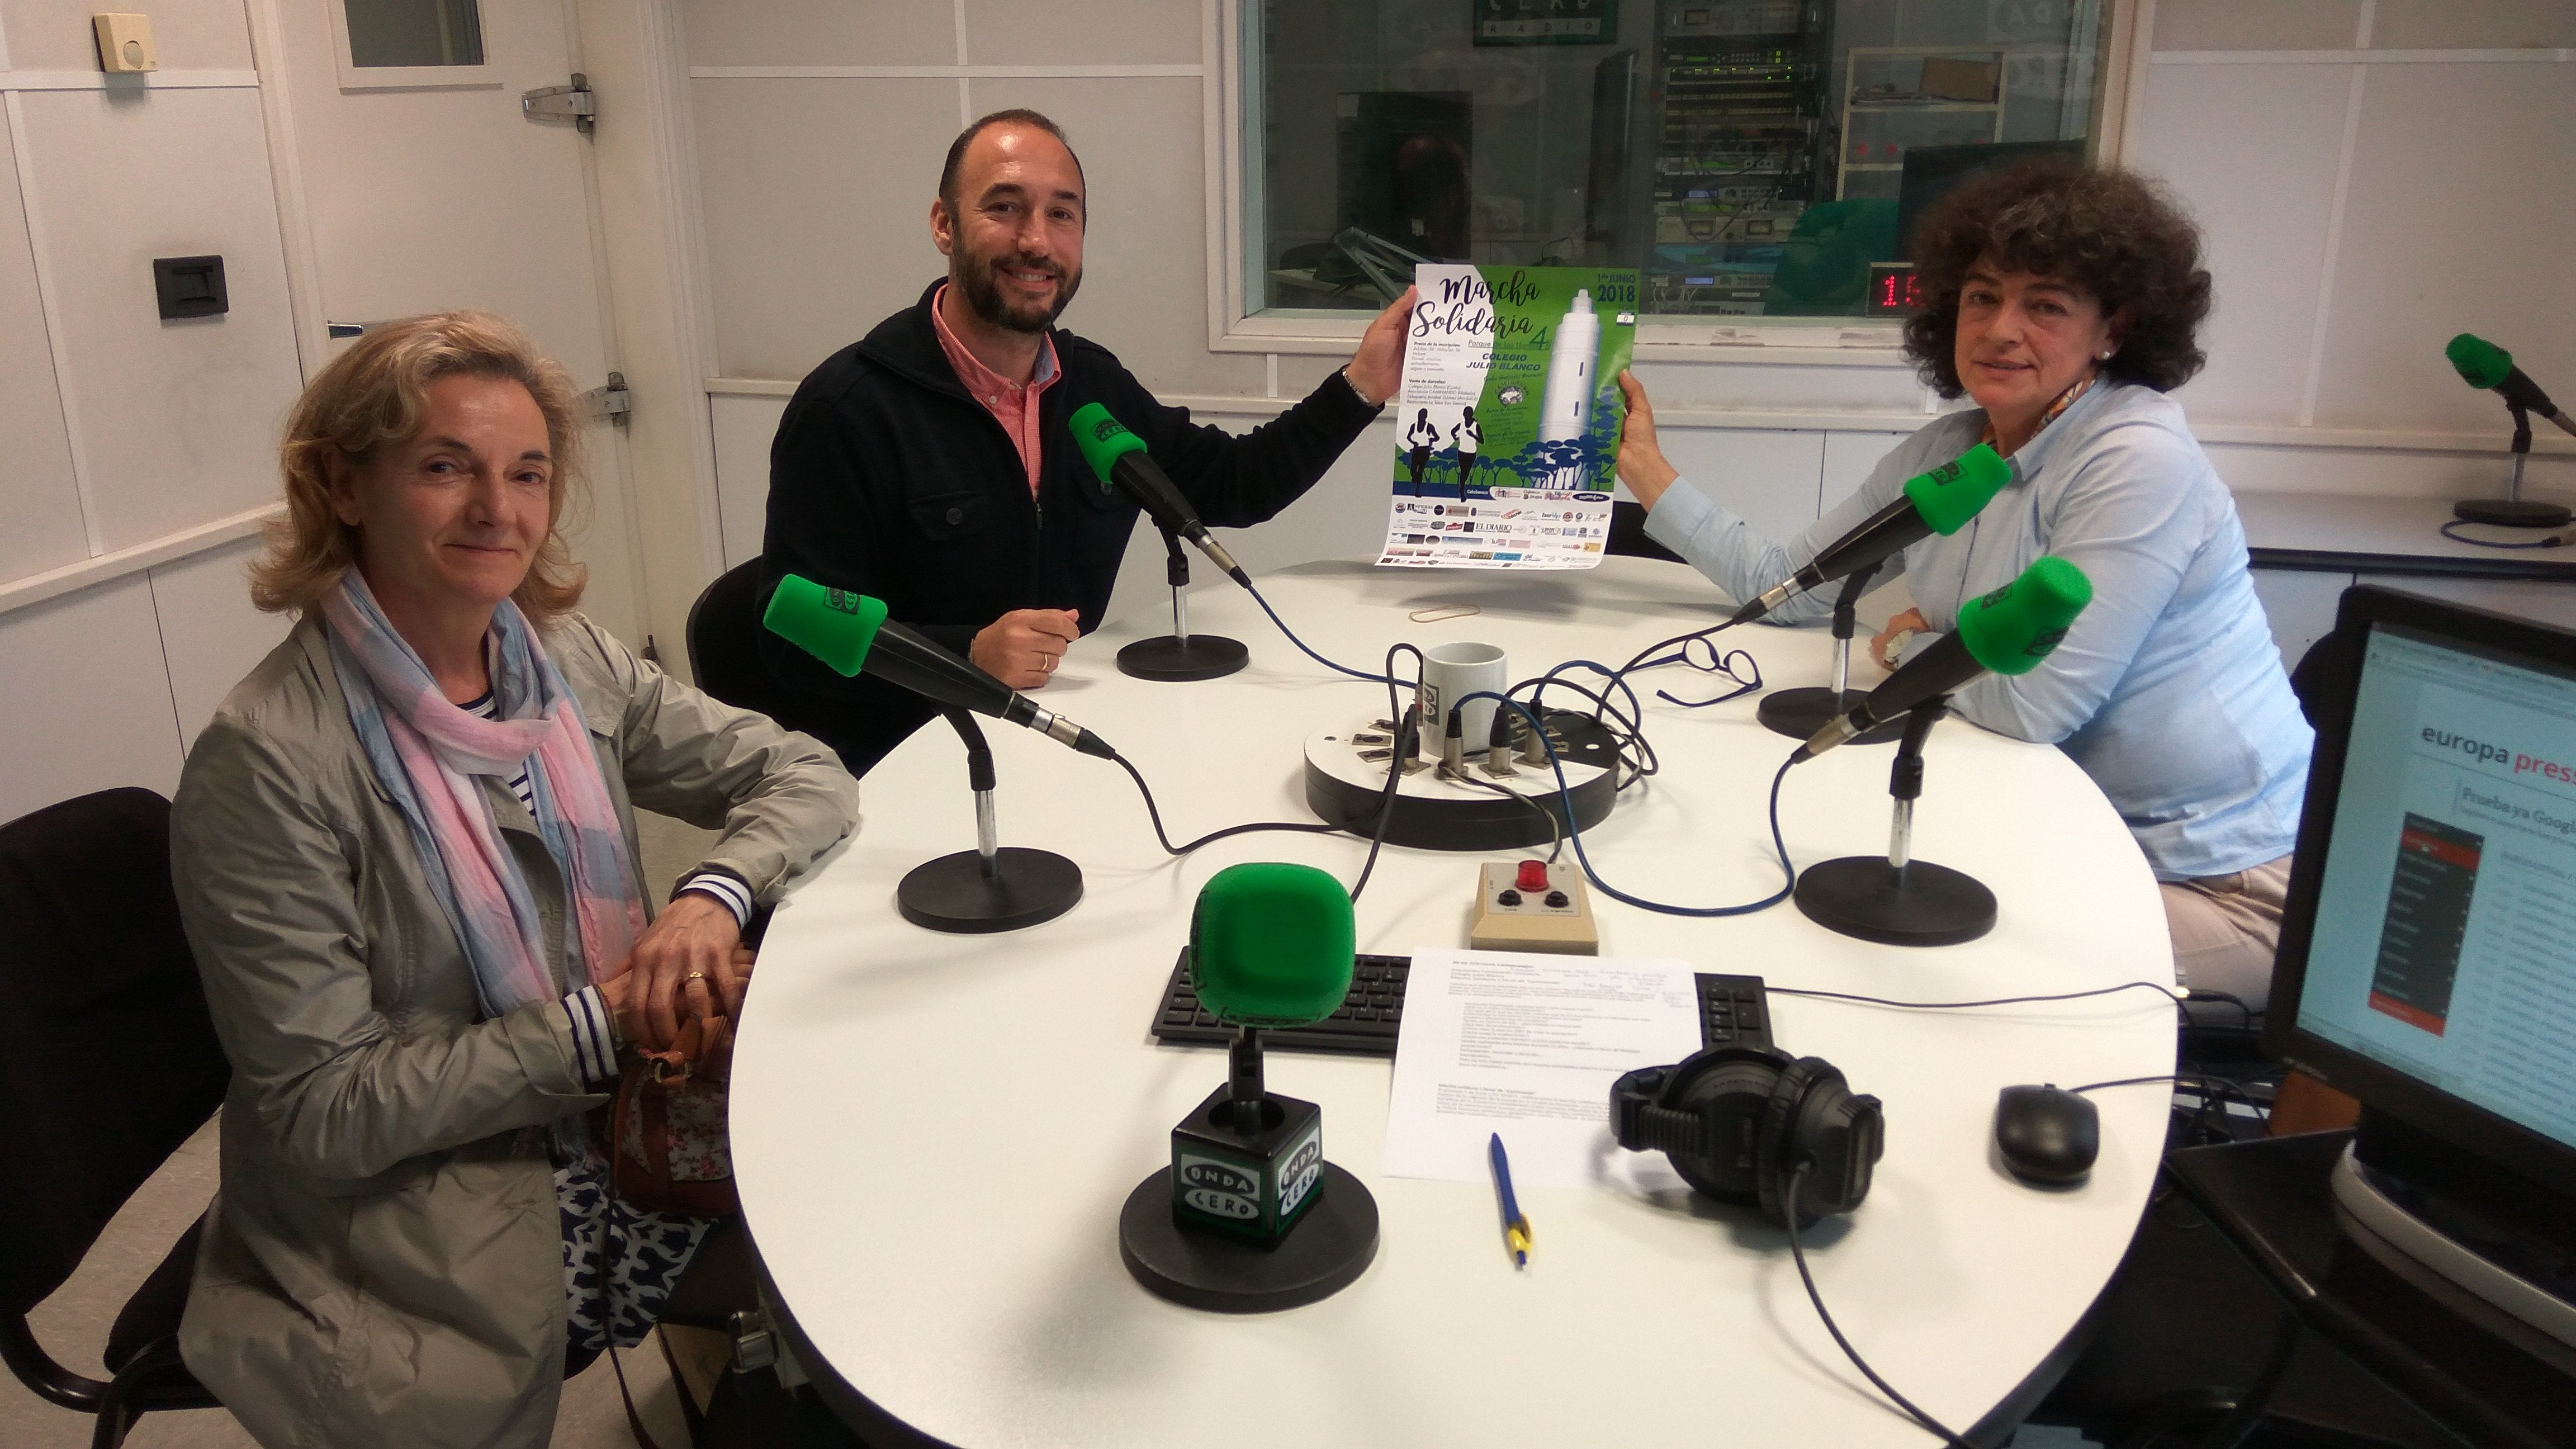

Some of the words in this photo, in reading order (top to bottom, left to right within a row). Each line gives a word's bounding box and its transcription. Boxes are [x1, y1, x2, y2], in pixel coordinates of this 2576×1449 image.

[1490, 22, 1592, 34] RADIO
[1440, 271, 1540, 306] Marcha
[1597, 284, 1635, 302] 2018
[1412, 301, 1534, 338] Solidaria
[2421, 727, 2509, 764] europa
[2462, 787, 2511, 812] Prueba
[1190, 1167, 1249, 1192] ONDA
[1284, 1146, 1315, 1185] ONDA
[1286, 1168, 1315, 1208] CERO
[1195, 1192, 1249, 1215] CERO
